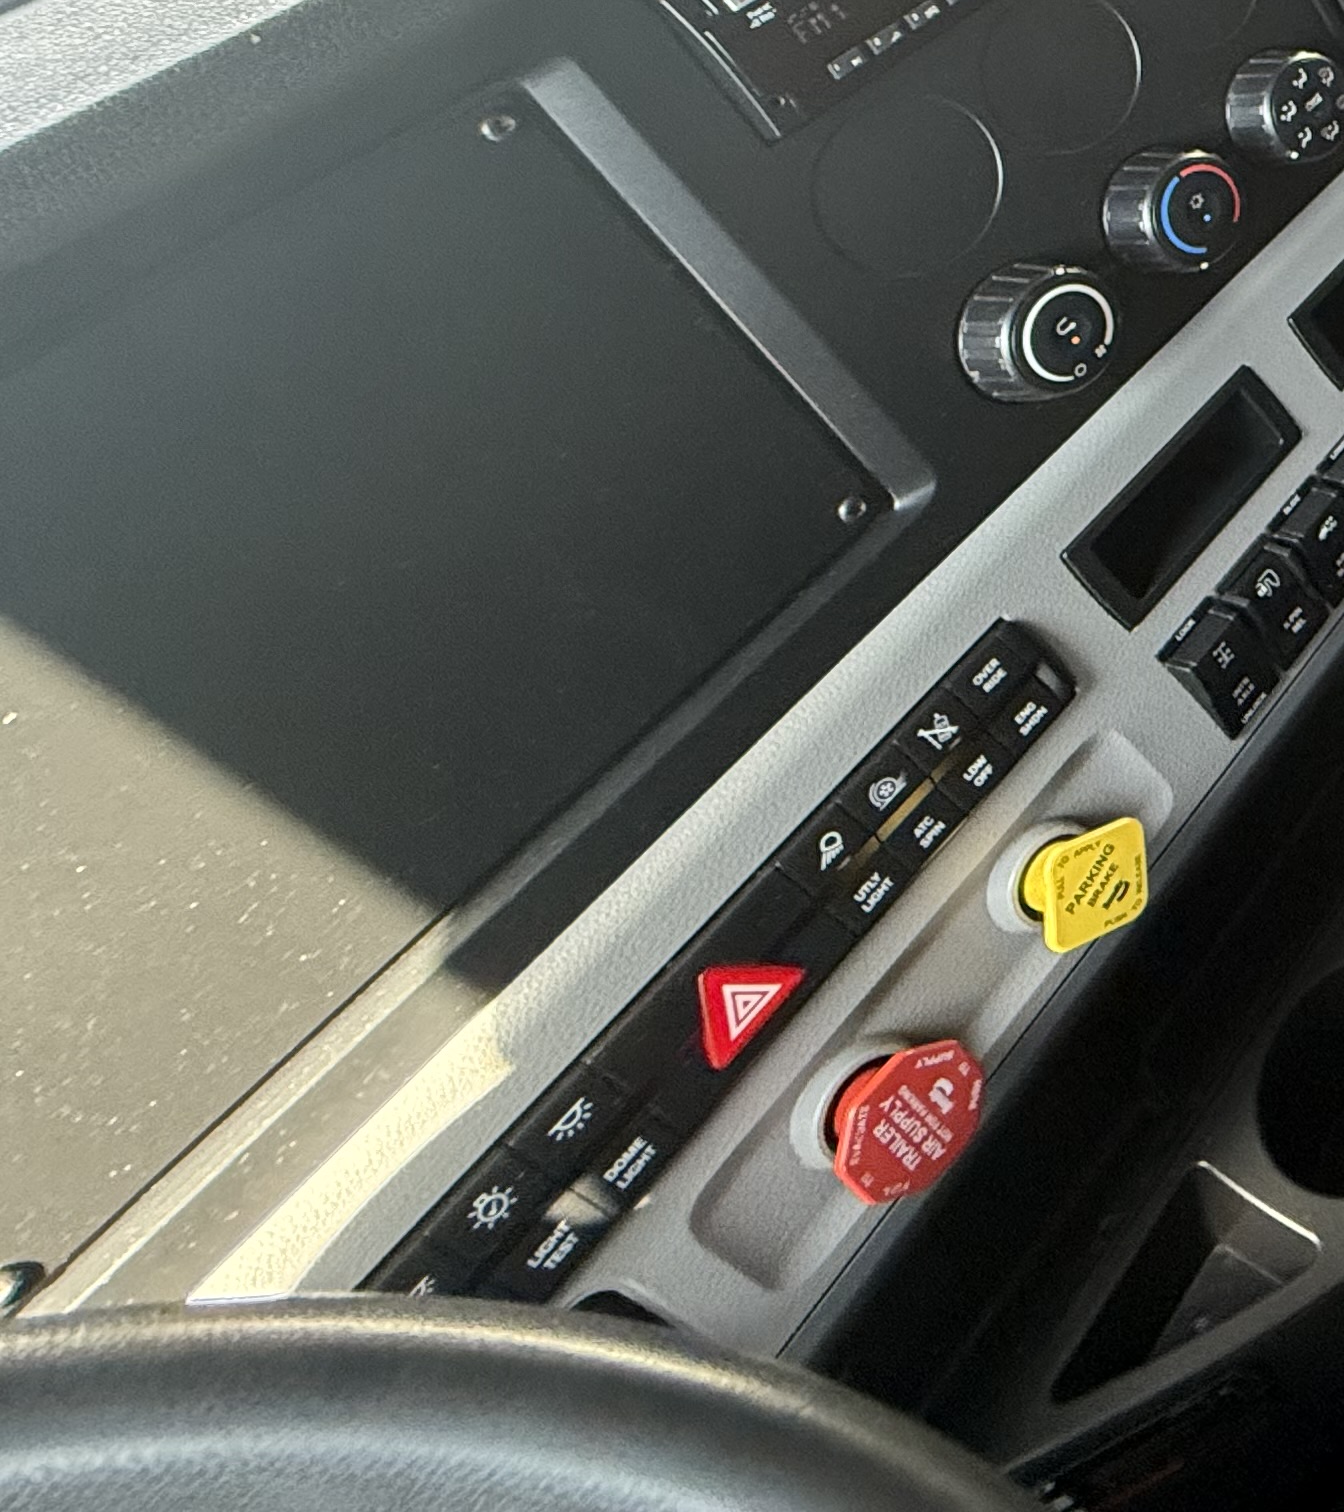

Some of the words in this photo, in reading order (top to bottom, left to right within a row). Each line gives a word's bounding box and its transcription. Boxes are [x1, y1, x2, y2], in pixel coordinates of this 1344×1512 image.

[972, 657, 1001, 686] OVER
[982, 667, 1008, 693] RIDE
[1014, 701, 1037, 725] ENG
[1019, 705, 1049, 737] SHDN
[962, 754, 988, 782] LDW
[973, 763, 994, 788] OFF
[913, 815, 936, 839] ATC
[919, 820, 947, 849] SPIN
[853, 871, 882, 903] UTLY
[861, 876, 895, 913] LIGHT
[1065, 843, 1116, 915] PARKING
[1087, 862, 1119, 908] BRAKE
[878, 1095, 929, 1144] SUPPLY
[603, 1136, 648, 1182] DOME
[872, 1119, 922, 1171] TRAILER
[920, 1139, 947, 1161] AIR
[616, 1144, 657, 1190] LIGHT
[527, 1217, 571, 1269] LIGHT
[542, 1232, 580, 1270] TEST
